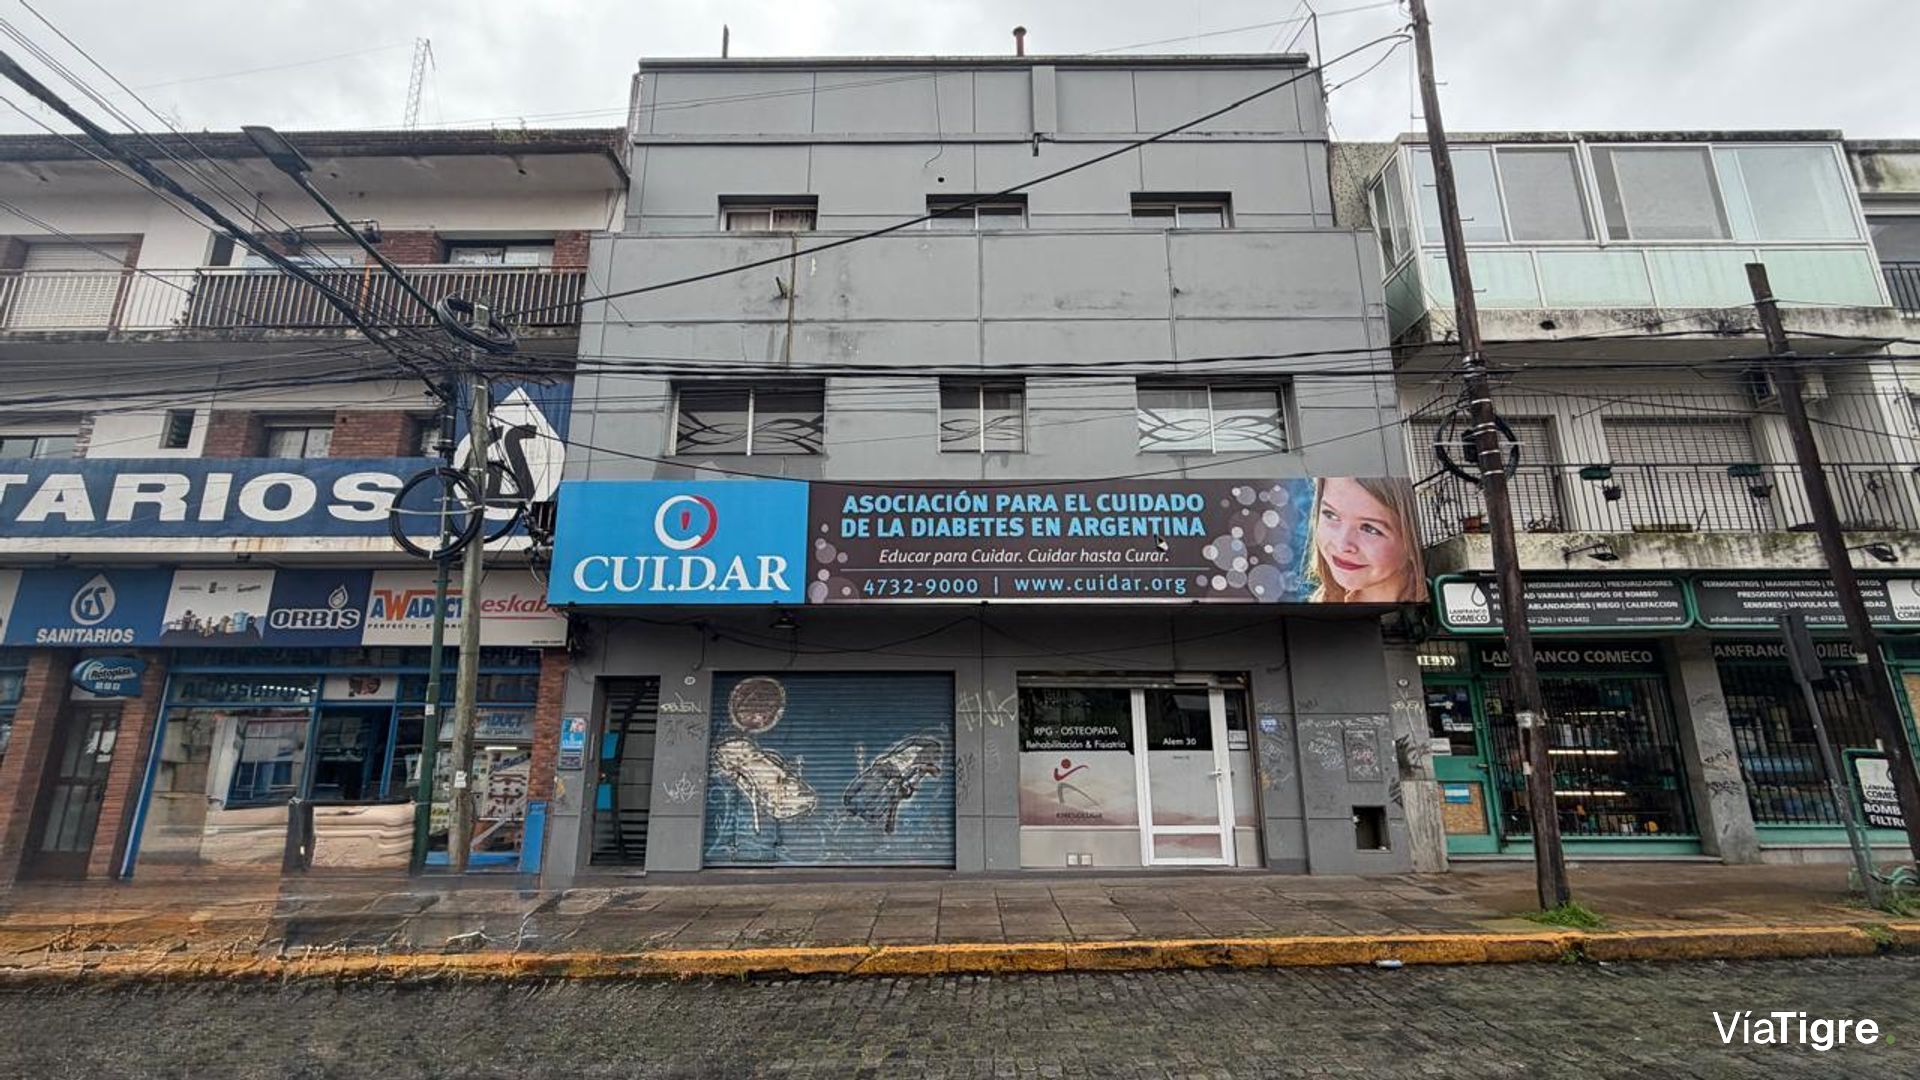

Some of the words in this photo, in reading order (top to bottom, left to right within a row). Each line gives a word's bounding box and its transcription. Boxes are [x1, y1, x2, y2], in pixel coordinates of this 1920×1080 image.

[0, 472, 403, 522] ARIOS
[842, 490, 988, 514] ASOCIACIÓN
[996, 494, 1061, 513] PARA
[1065, 493, 1091, 513] EL
[1096, 493, 1205, 513] CUIDADO
[841, 518, 870, 538] DE
[877, 518, 905, 538] LA
[911, 517, 1025, 538] DIABETES
[1032, 517, 1061, 538] EN
[1068, 516, 1206, 538] ARGENTINA
[879, 549, 931, 564] Educar
[933, 552, 968, 567] para
[970, 548, 1024, 564] Cuidar.
[1028, 548, 1078, 563] Cuidar
[1080, 548, 1122, 563] hasta
[1125, 549, 1170, 563] Curar.
[863, 578, 979, 595] 4732-9000
[1015, 577, 1187, 595] www.cuidar.org
[370, 589, 464, 621] AWADCT
[270, 608, 361, 629] ORBIS
[36, 628, 135, 644] SANITARIOS
[1482, 650, 1580, 663] LANANCO
[1583, 650, 1653, 663] COMECO
[1033, 726, 1053, 736] RPG
[1060, 726, 1118, 736] OSTEOPATIA
[1162, 737, 1185, 746] Alem
[1186, 737, 1197, 746] 30
[1866, 791, 1898, 799] COMEC
